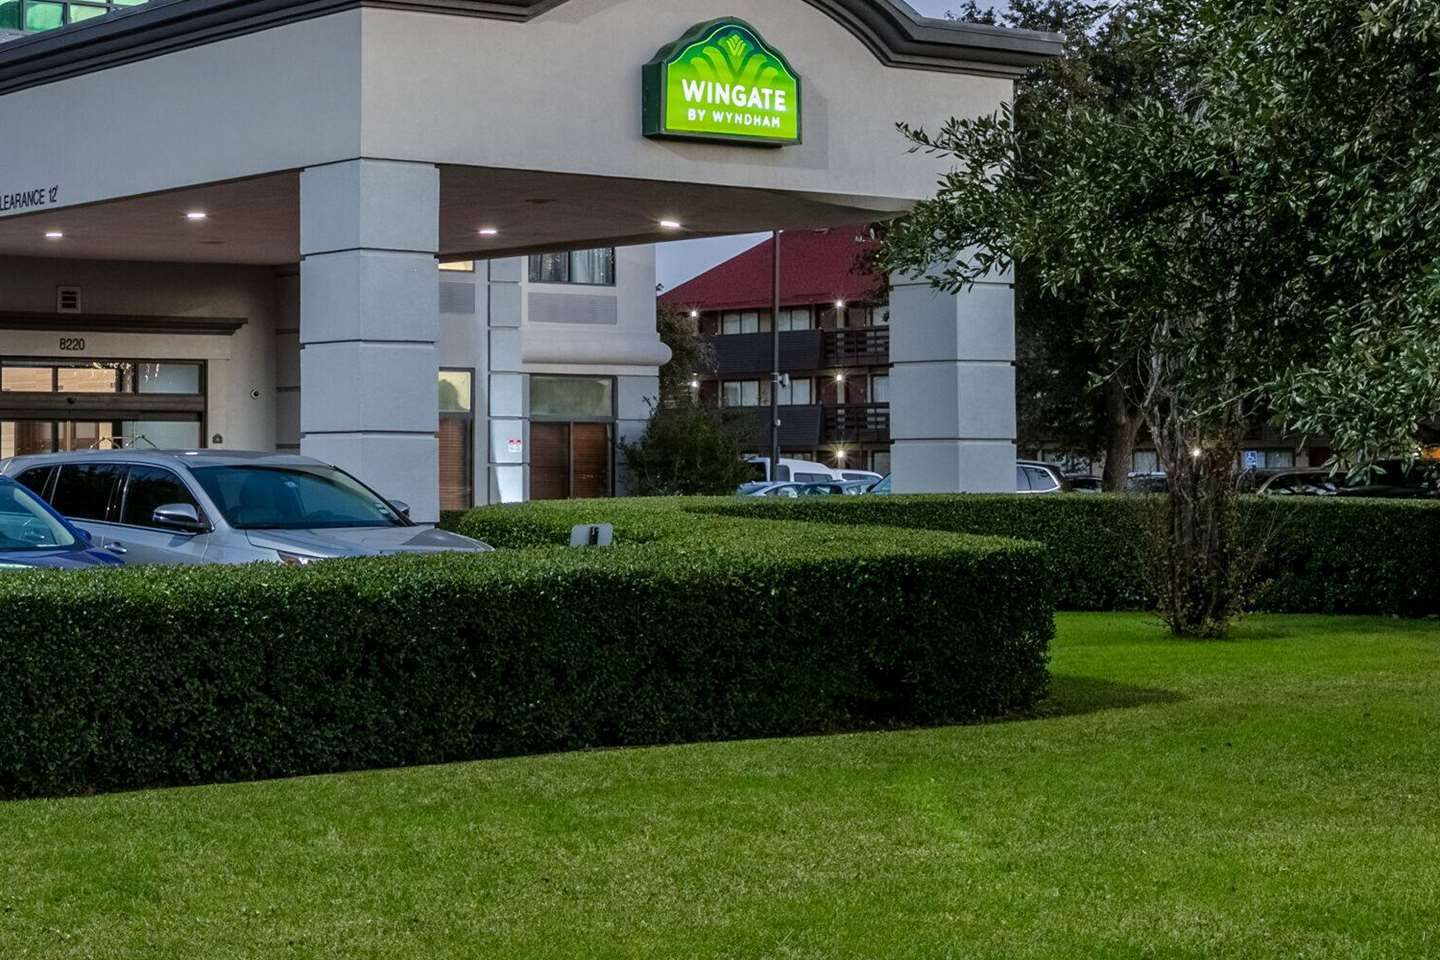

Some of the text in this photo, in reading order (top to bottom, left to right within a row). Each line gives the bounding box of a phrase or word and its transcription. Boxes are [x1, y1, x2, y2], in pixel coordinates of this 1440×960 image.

[681, 78, 787, 112] WINGATE
[687, 108, 780, 128] BY WYNDHAM
[59, 337, 86, 351] 8220
